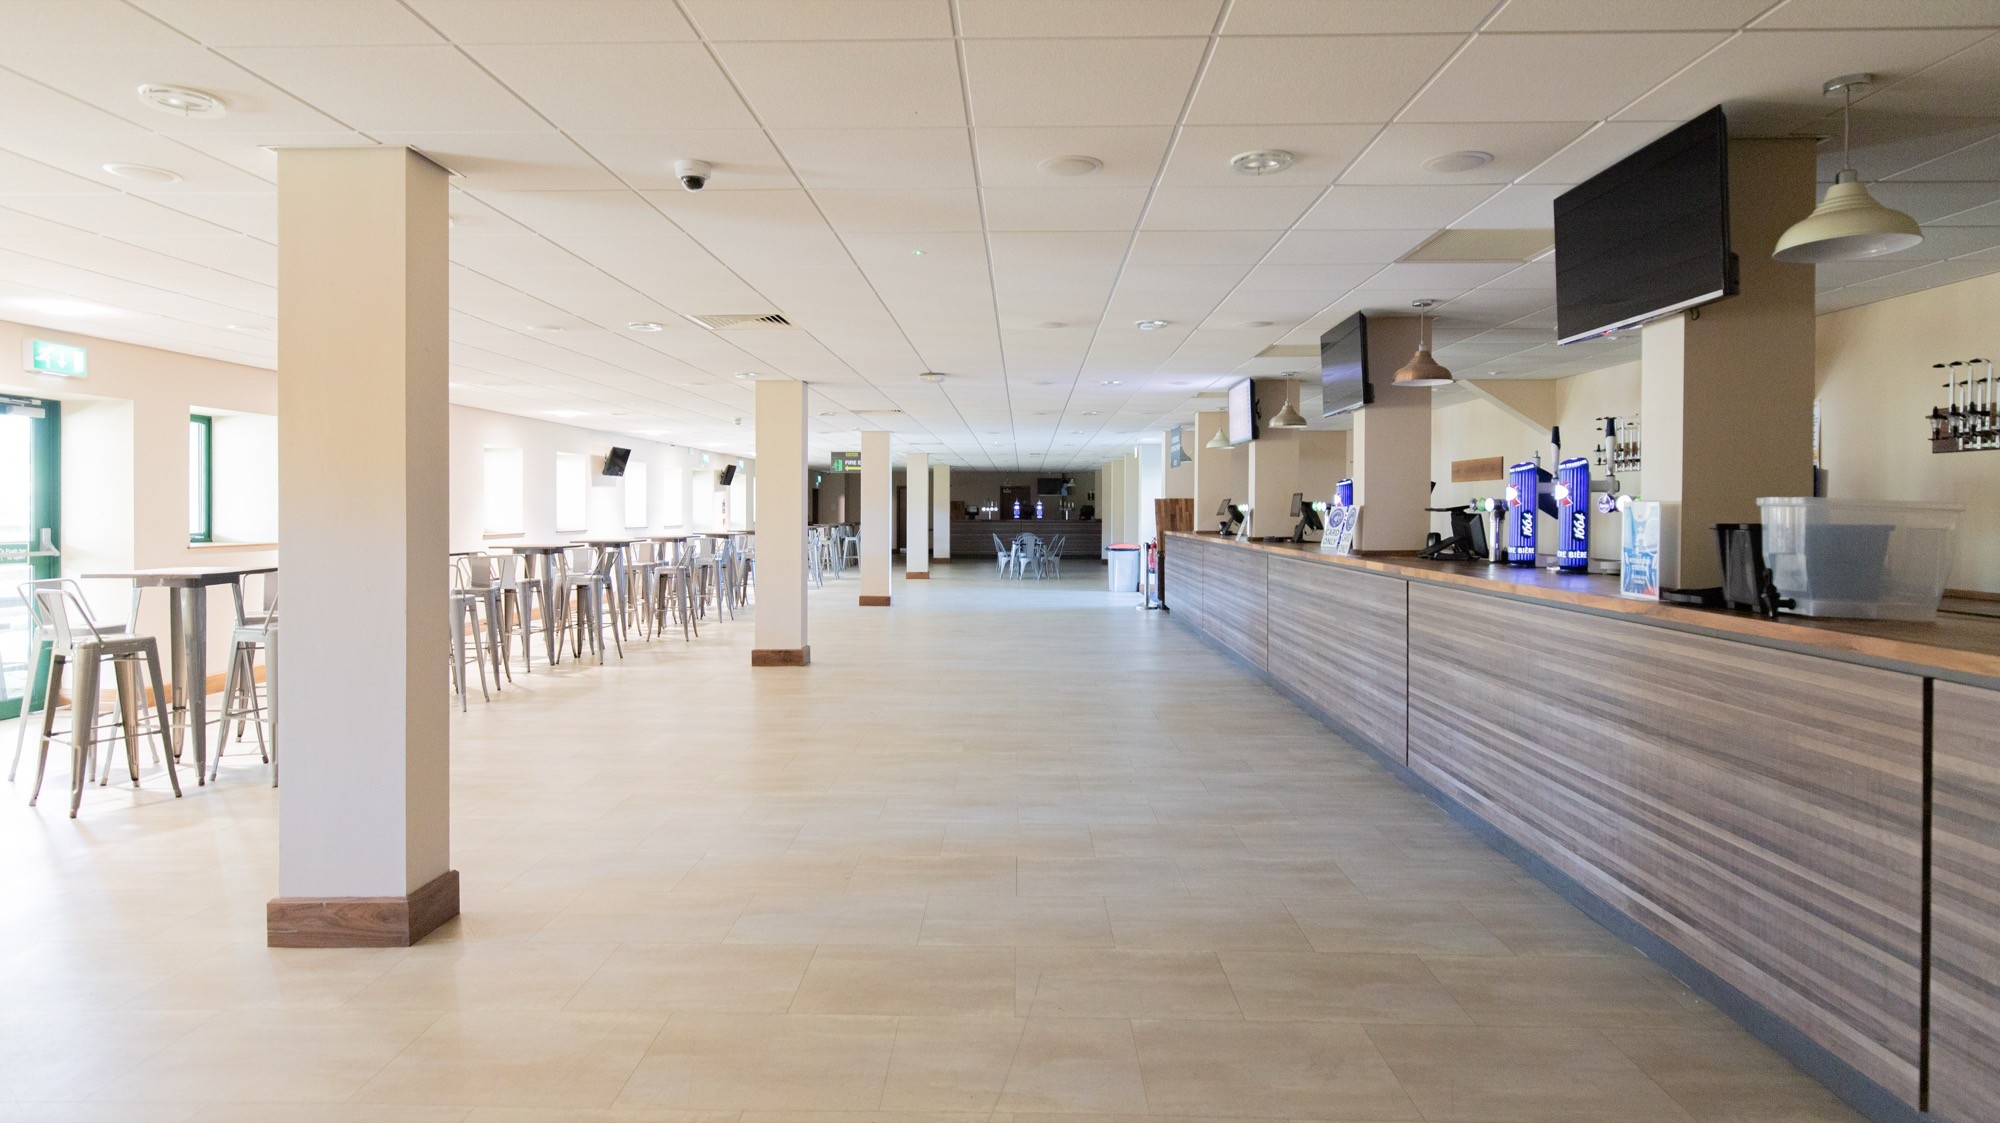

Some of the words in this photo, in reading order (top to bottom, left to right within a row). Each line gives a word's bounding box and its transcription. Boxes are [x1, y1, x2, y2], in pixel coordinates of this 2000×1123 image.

[1522, 512, 1532, 536] 1664
[1574, 513, 1586, 540] 1664
[1568, 550, 1587, 558] BIÈRE
